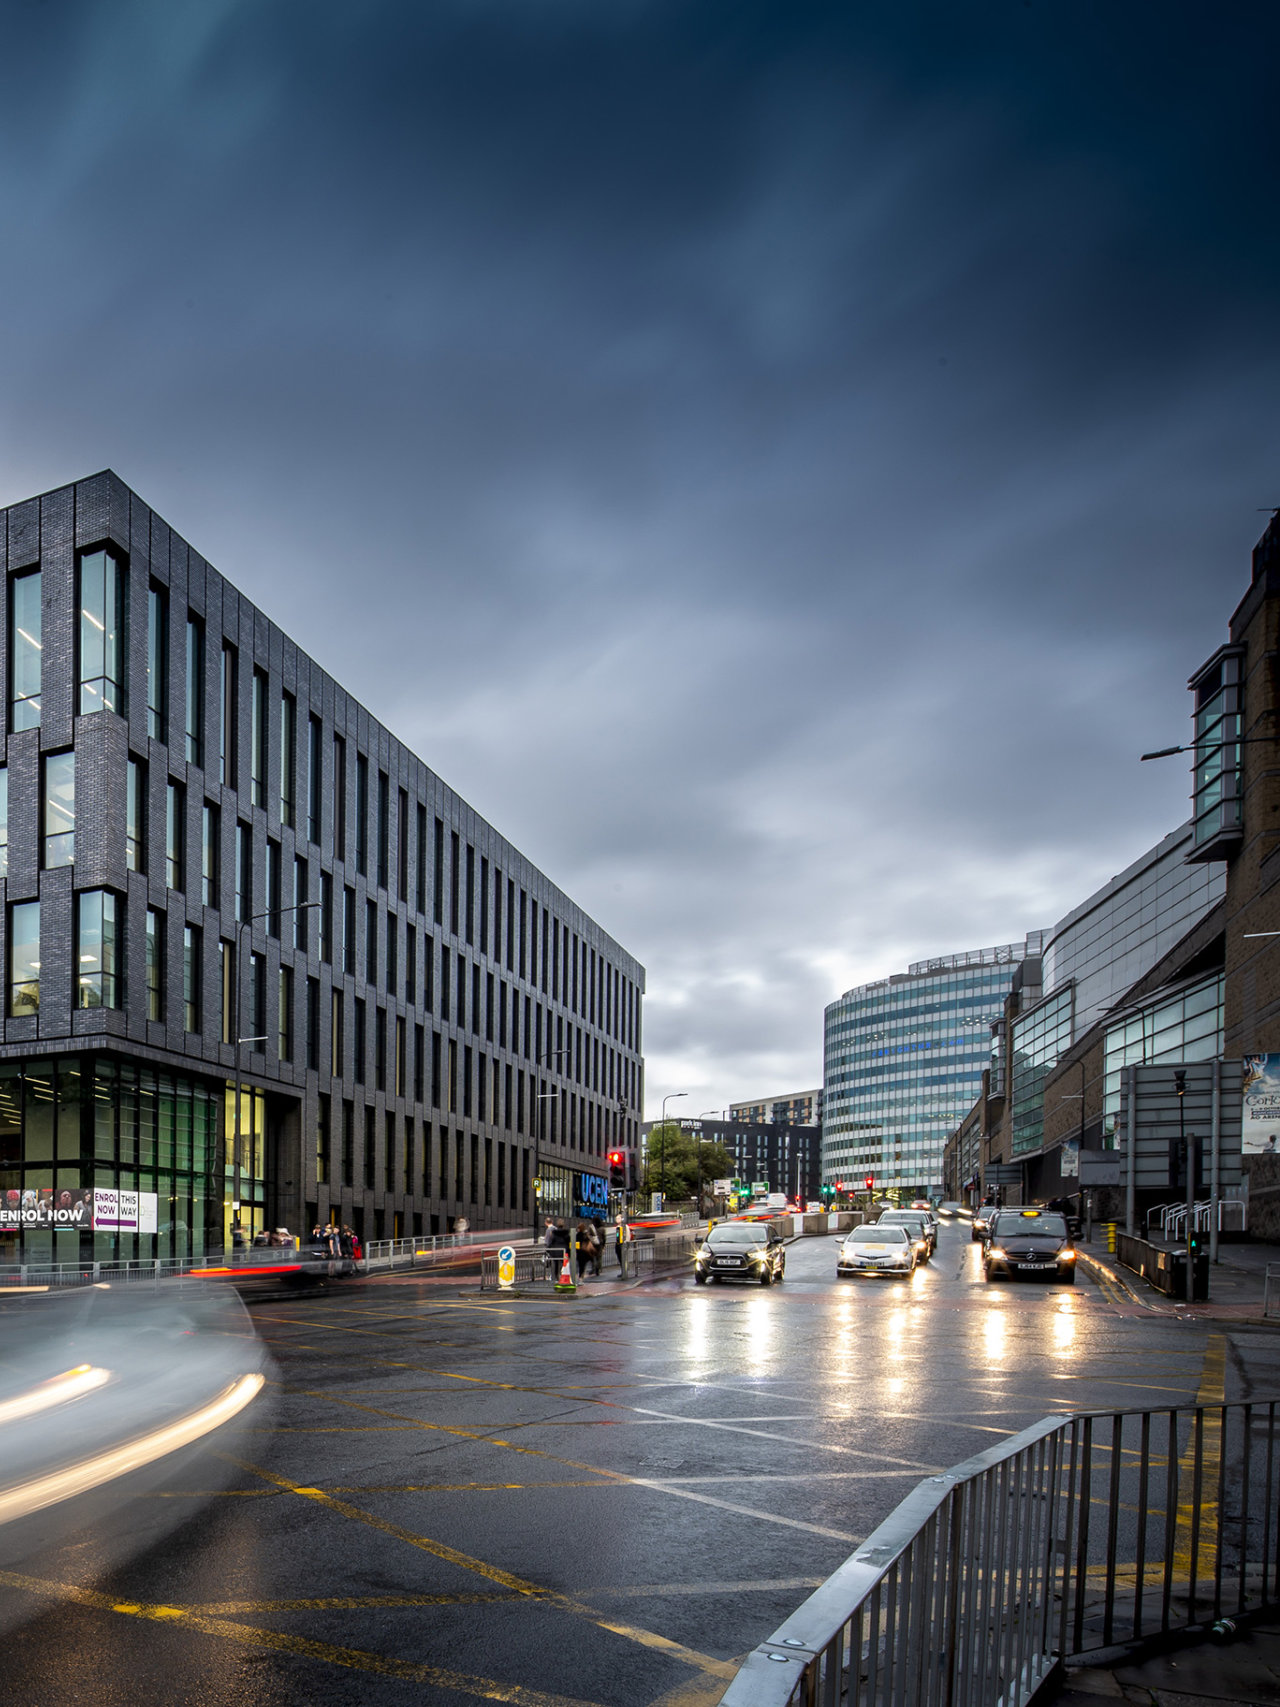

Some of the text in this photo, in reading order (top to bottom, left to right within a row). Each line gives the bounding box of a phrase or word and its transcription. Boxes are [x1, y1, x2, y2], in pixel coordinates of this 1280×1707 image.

[581, 1173, 608, 1205] UCEN
[95, 1193, 118, 1203] ENROL
[121, 1195, 136, 1205] THIS
[97, 1205, 115, 1214] NOW
[121, 1207, 136, 1216] WAY
[0, 1209, 84, 1222] ENROL NOW
